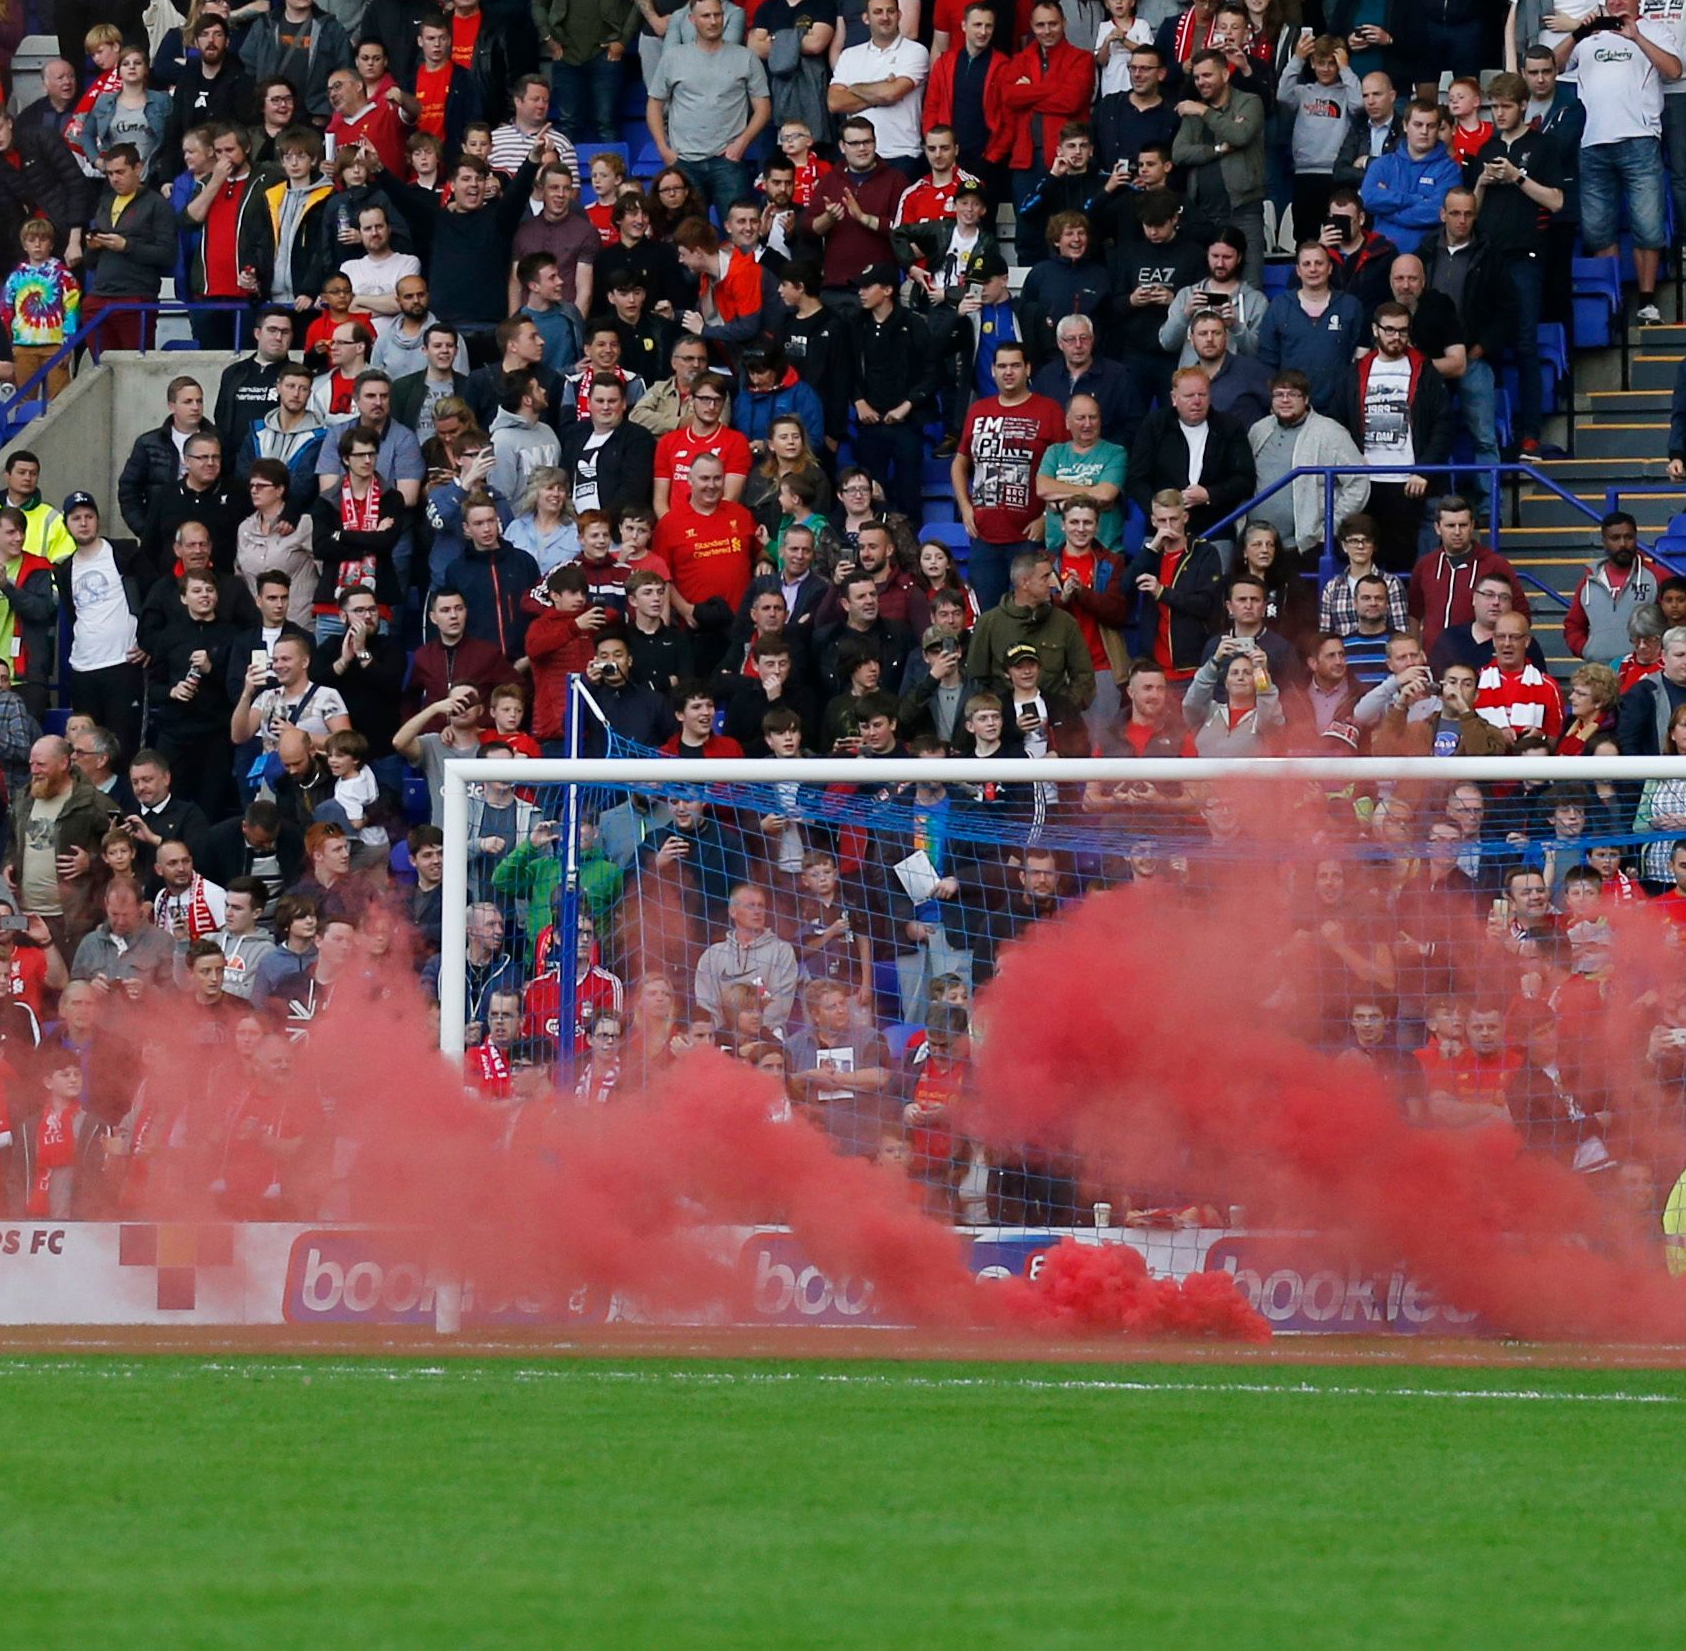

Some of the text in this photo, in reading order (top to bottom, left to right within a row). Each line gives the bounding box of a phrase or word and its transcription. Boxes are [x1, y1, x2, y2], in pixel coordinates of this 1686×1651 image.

[1594, 48, 1633, 63] Carlsberg
[1138, 267, 1176, 283] EA7
[972, 416, 1003, 435] EM
[692, 537, 729, 550] Standard
[692, 546, 731, 559] Chartered
[29, 1230, 66, 1255] FC
